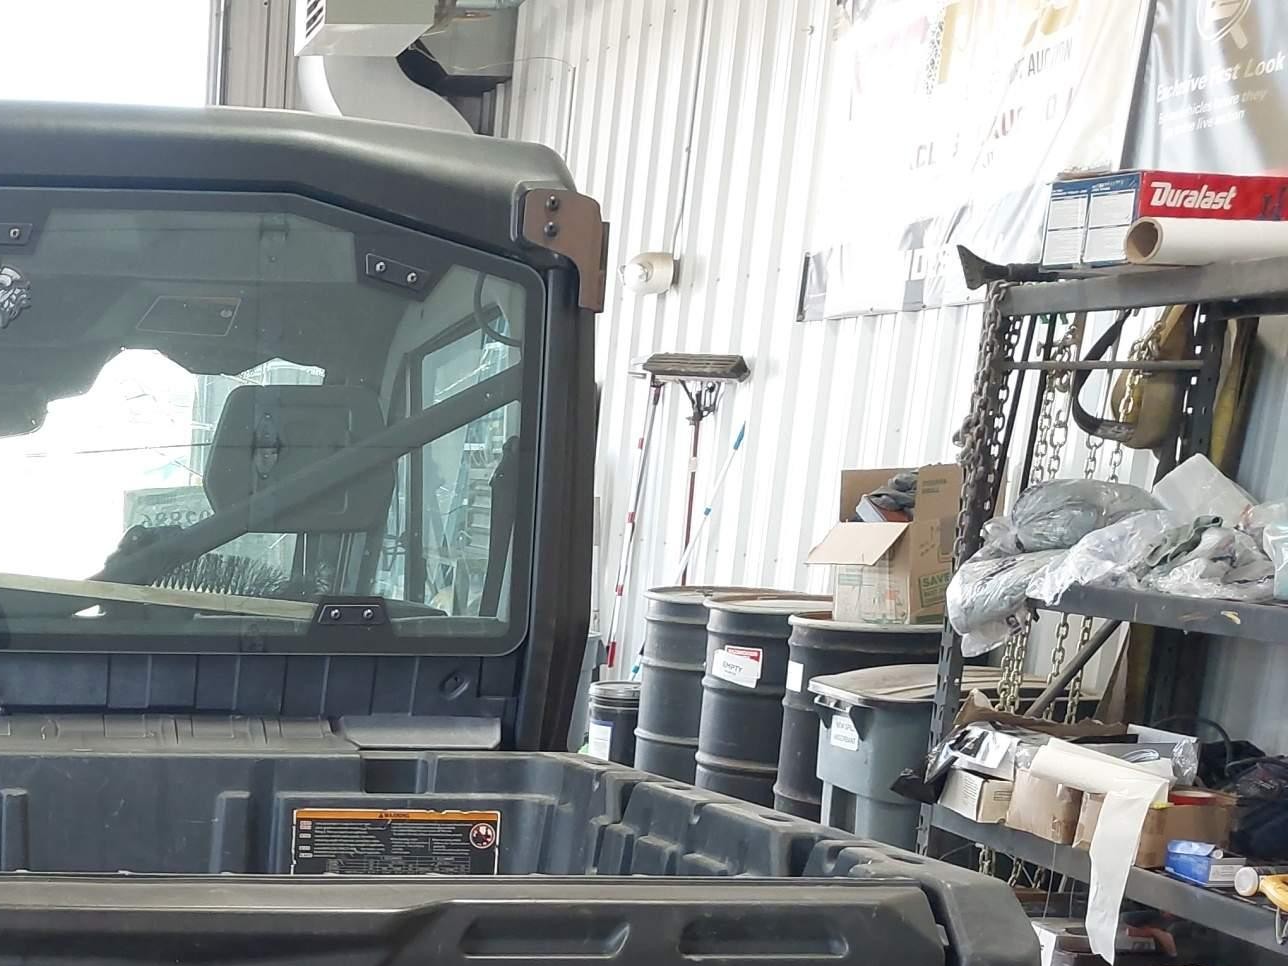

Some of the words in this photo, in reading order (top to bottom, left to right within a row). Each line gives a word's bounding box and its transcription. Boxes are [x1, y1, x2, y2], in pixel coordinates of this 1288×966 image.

[1027, 37, 1073, 77] AUCN
[1244, 51, 1286, 78] Look
[1150, 182, 1238, 210] Duralast
